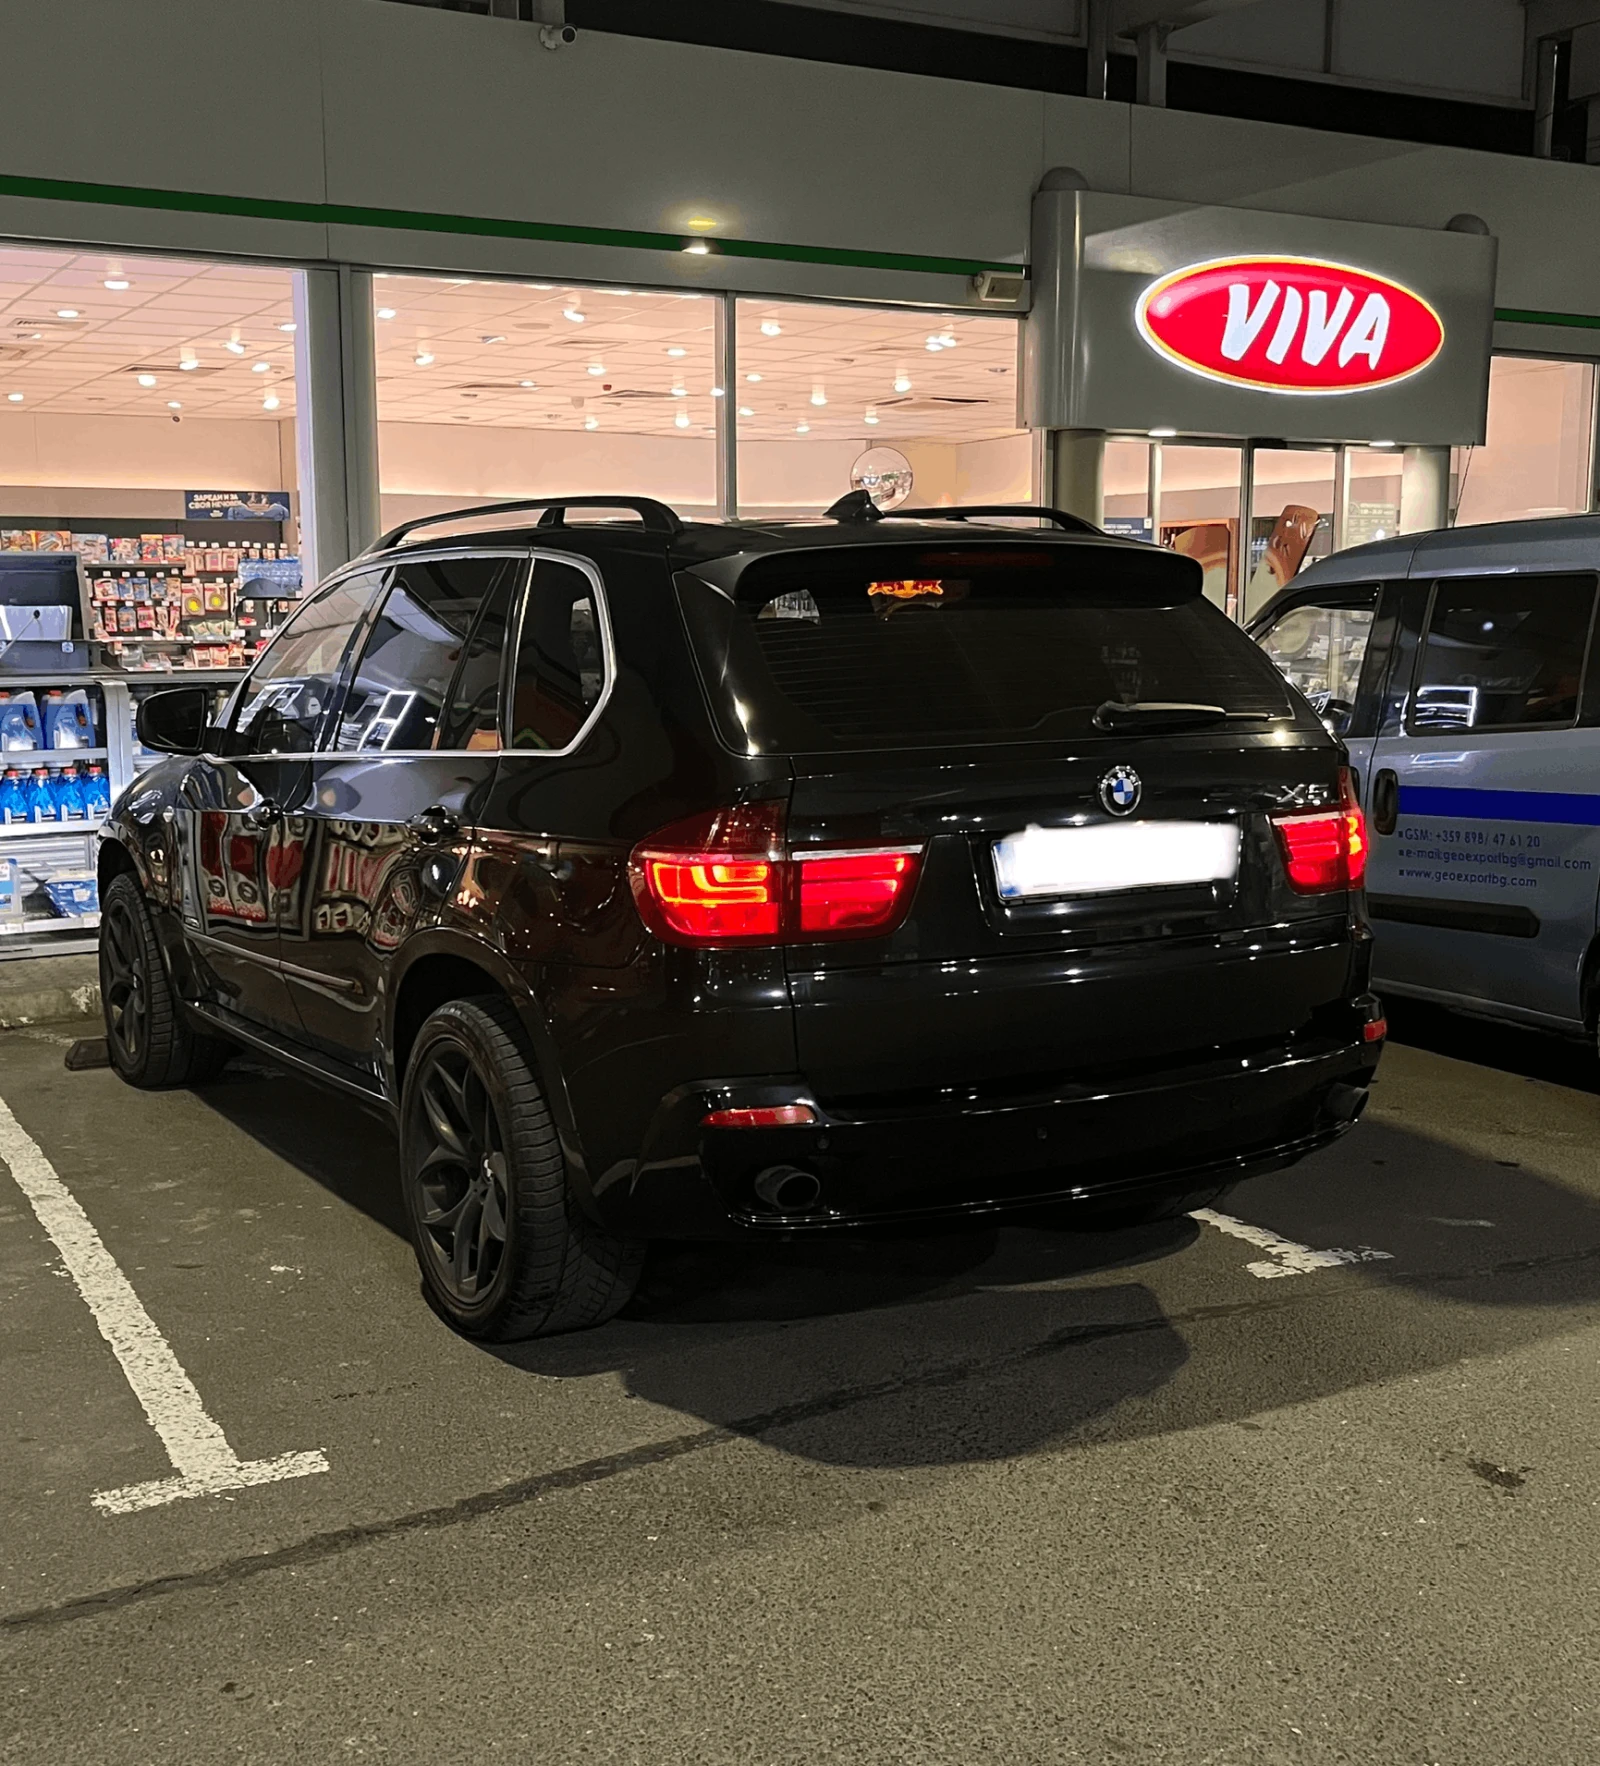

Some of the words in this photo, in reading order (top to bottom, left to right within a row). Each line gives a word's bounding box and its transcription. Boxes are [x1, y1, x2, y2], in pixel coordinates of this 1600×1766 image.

[1221, 279, 1390, 370] VIVA
[1277, 784, 1328, 806] X5
[1405, 828, 1432, 841] GSM:
[1436, 830, 1460, 842] +359
[1464, 831, 1488, 845] 898/
[1493, 833, 1505, 846] 47
[1510, 835, 1521, 846] 61
[1527, 835, 1540, 847] 20
[1406, 869, 1537, 887] www.geoexportbg.com
